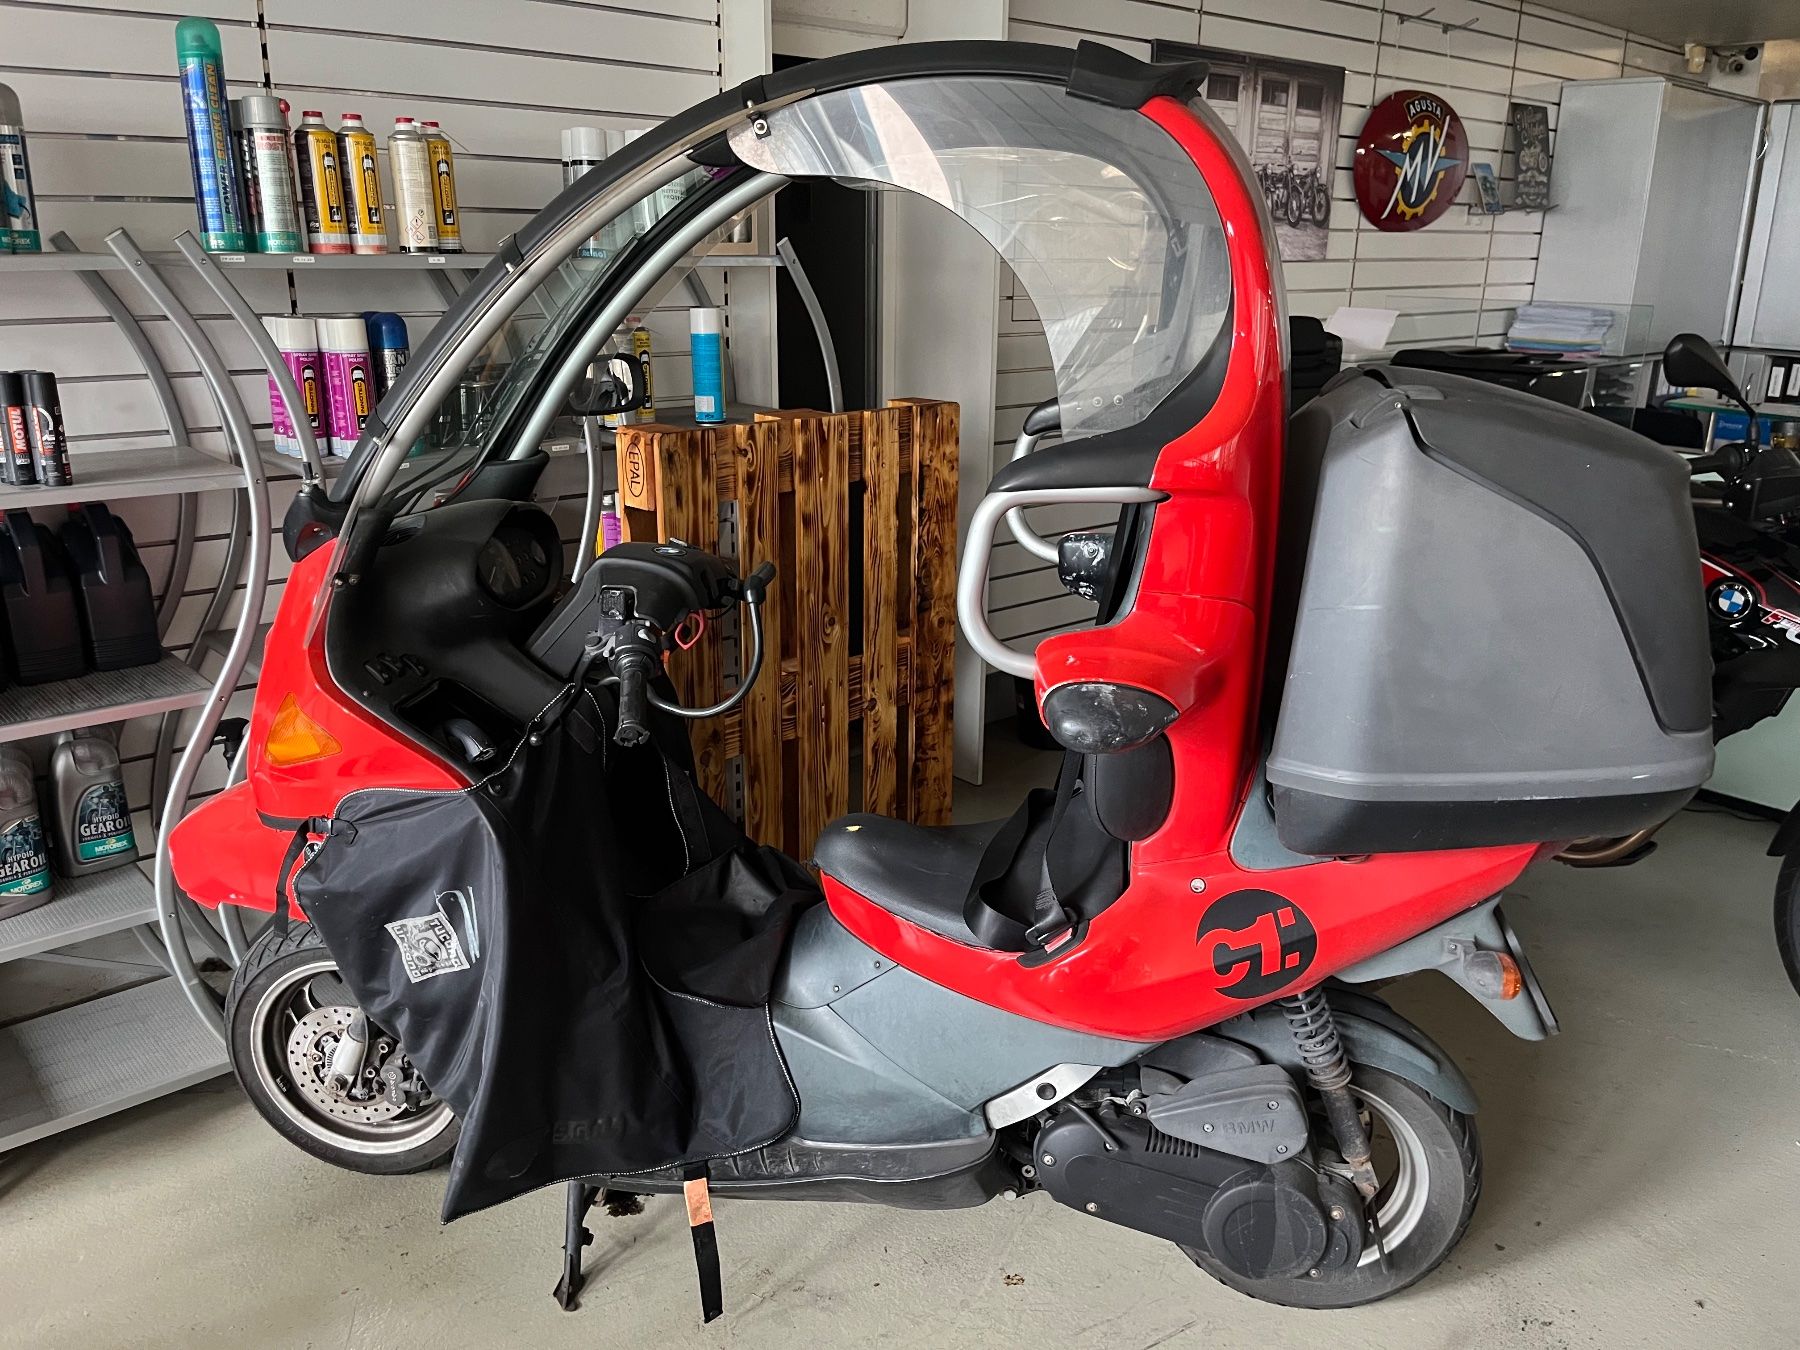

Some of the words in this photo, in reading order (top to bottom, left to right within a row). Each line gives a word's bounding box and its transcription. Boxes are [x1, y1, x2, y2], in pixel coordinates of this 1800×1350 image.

[206, 64, 219, 109] CLEAN
[1409, 99, 1442, 119] AGUSTA
[212, 112, 226, 160] BRAKE
[1380, 115, 1450, 219] MV
[220, 164, 235, 215] POWER
[10, 408, 27, 450] MOTUL
[628, 451, 641, 489] EPAL
[80, 819, 115, 837] GEAR
[115, 815, 131, 830] OIL
[93, 813, 120, 823] HYPOID
[7, 850, 34, 862] HYPOID
[94, 839, 128, 853] MOTOREX
[30, 853, 46, 868] OIL
[10, 880, 43, 893] MOTOREX
[1222, 1118, 1275, 1135] BMW
